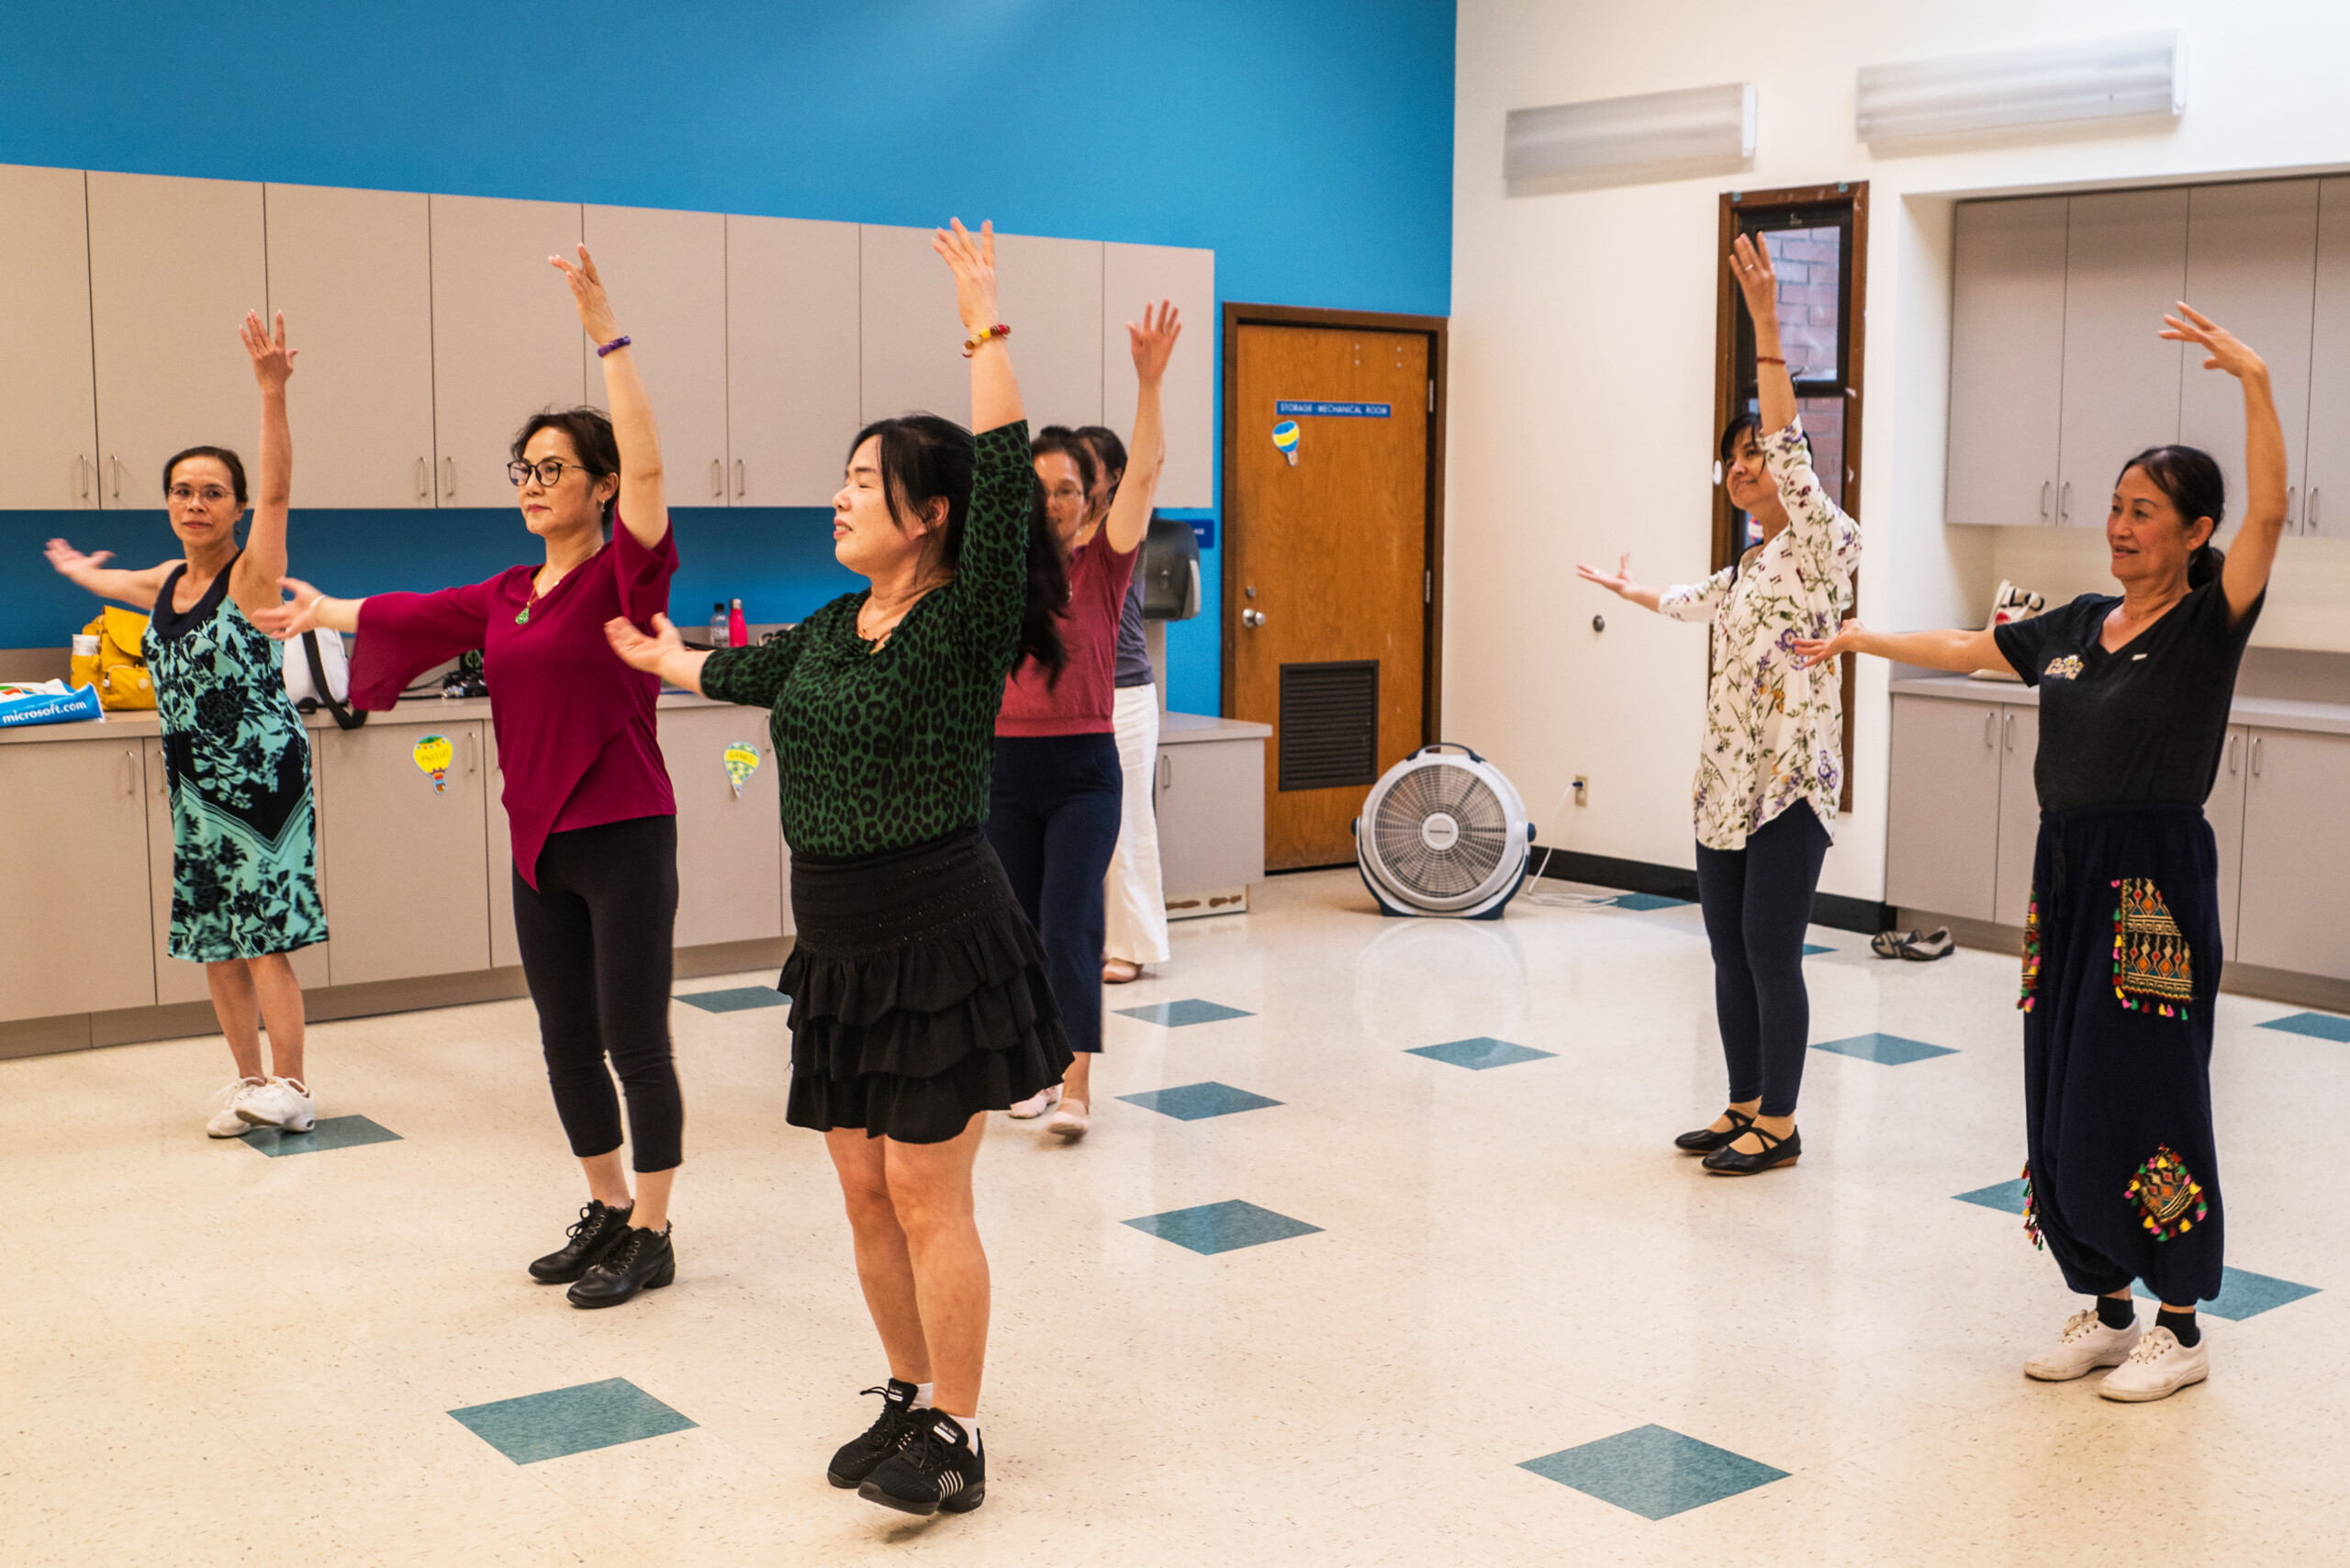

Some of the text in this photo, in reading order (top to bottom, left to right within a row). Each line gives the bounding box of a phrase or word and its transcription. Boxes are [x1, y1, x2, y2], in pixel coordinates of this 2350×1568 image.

[1281, 403, 1313, 412] STORAGE
[1318, 405, 1362, 414] MECHANICAL
[1365, 406, 1388, 415] ROOM
[2, 700, 87, 723] microsoft.com
